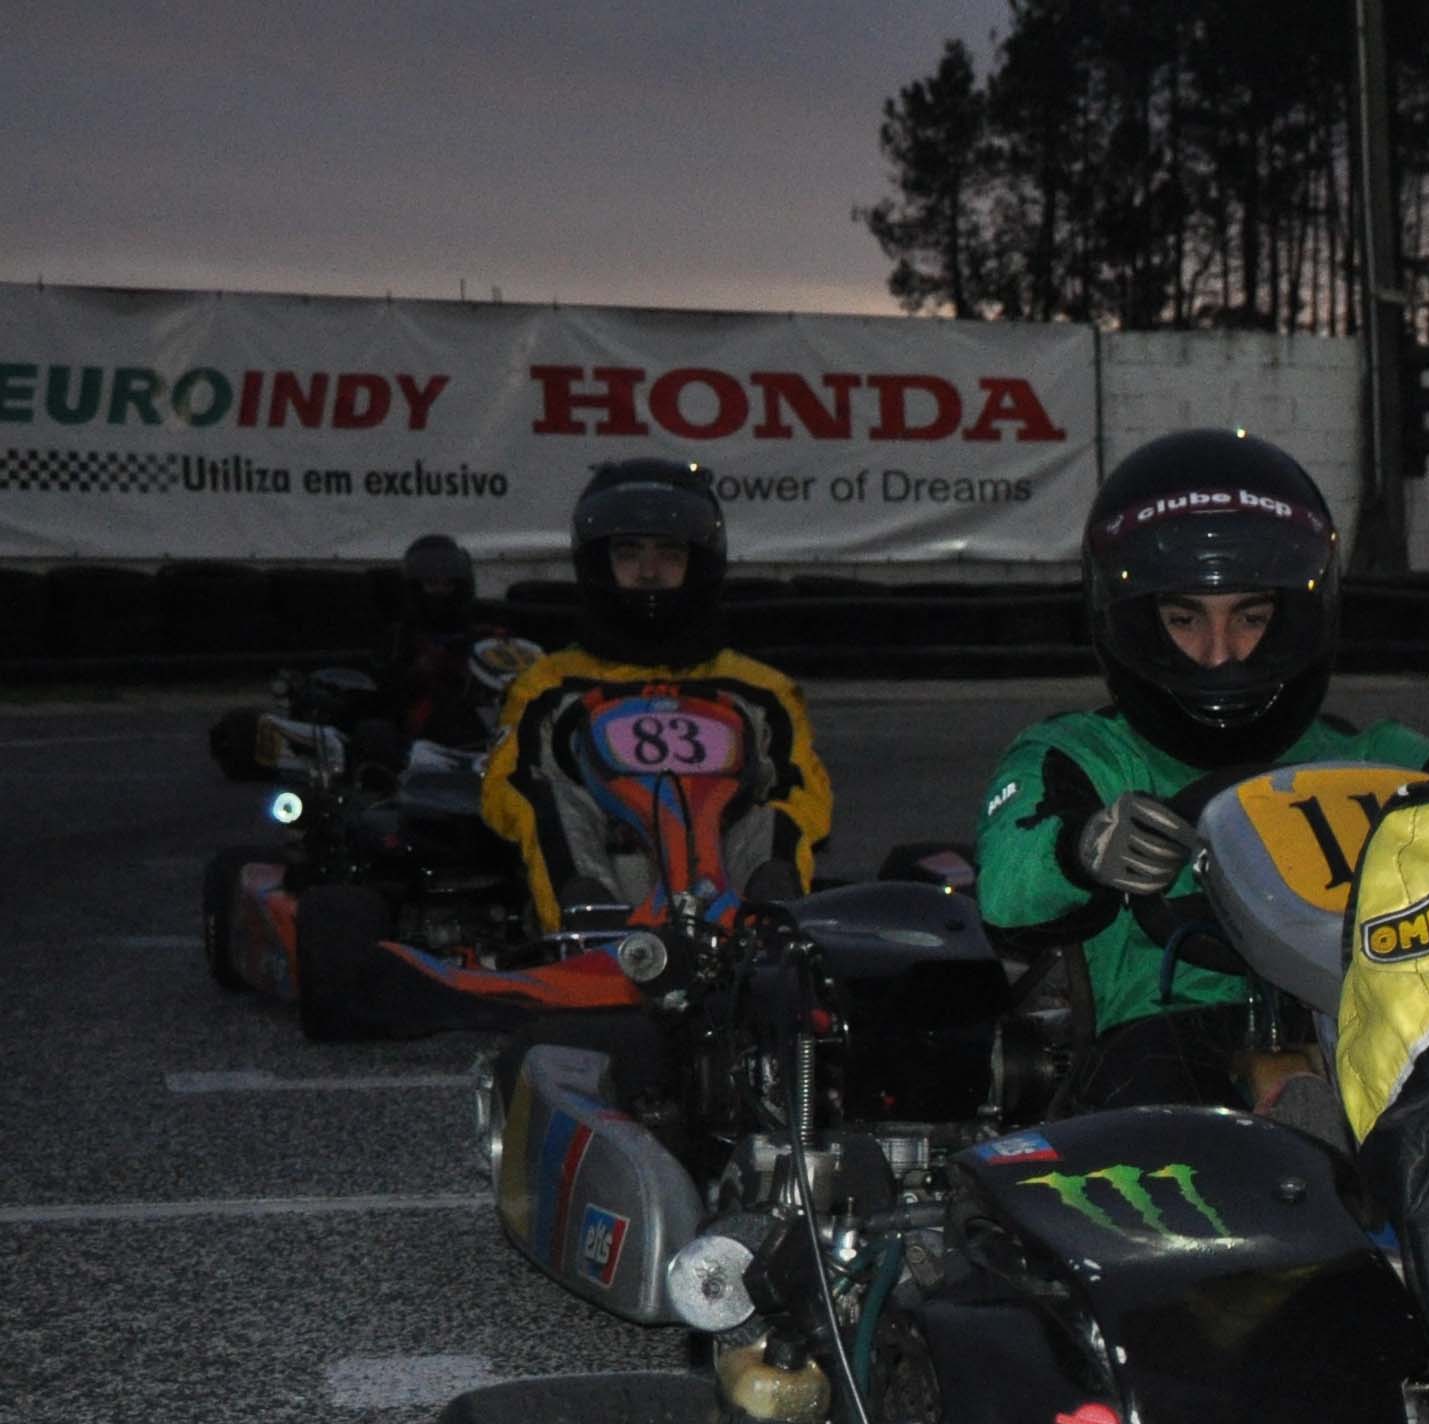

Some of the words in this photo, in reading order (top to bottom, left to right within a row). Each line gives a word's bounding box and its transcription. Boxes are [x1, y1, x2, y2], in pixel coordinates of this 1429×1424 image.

[0, 362, 451, 431] EUROINDY
[530, 364, 1067, 442] HONDA
[182, 455, 291, 494] Utiliza
[305, 470, 352, 496] em
[364, 460, 509, 498] exclusivo
[831, 467, 868, 502] of
[883, 470, 1032, 503] Dreams
[1137, 490, 1232, 521] clube
[1238, 489, 1293, 518] bcp
[633, 716, 706, 765] 83
